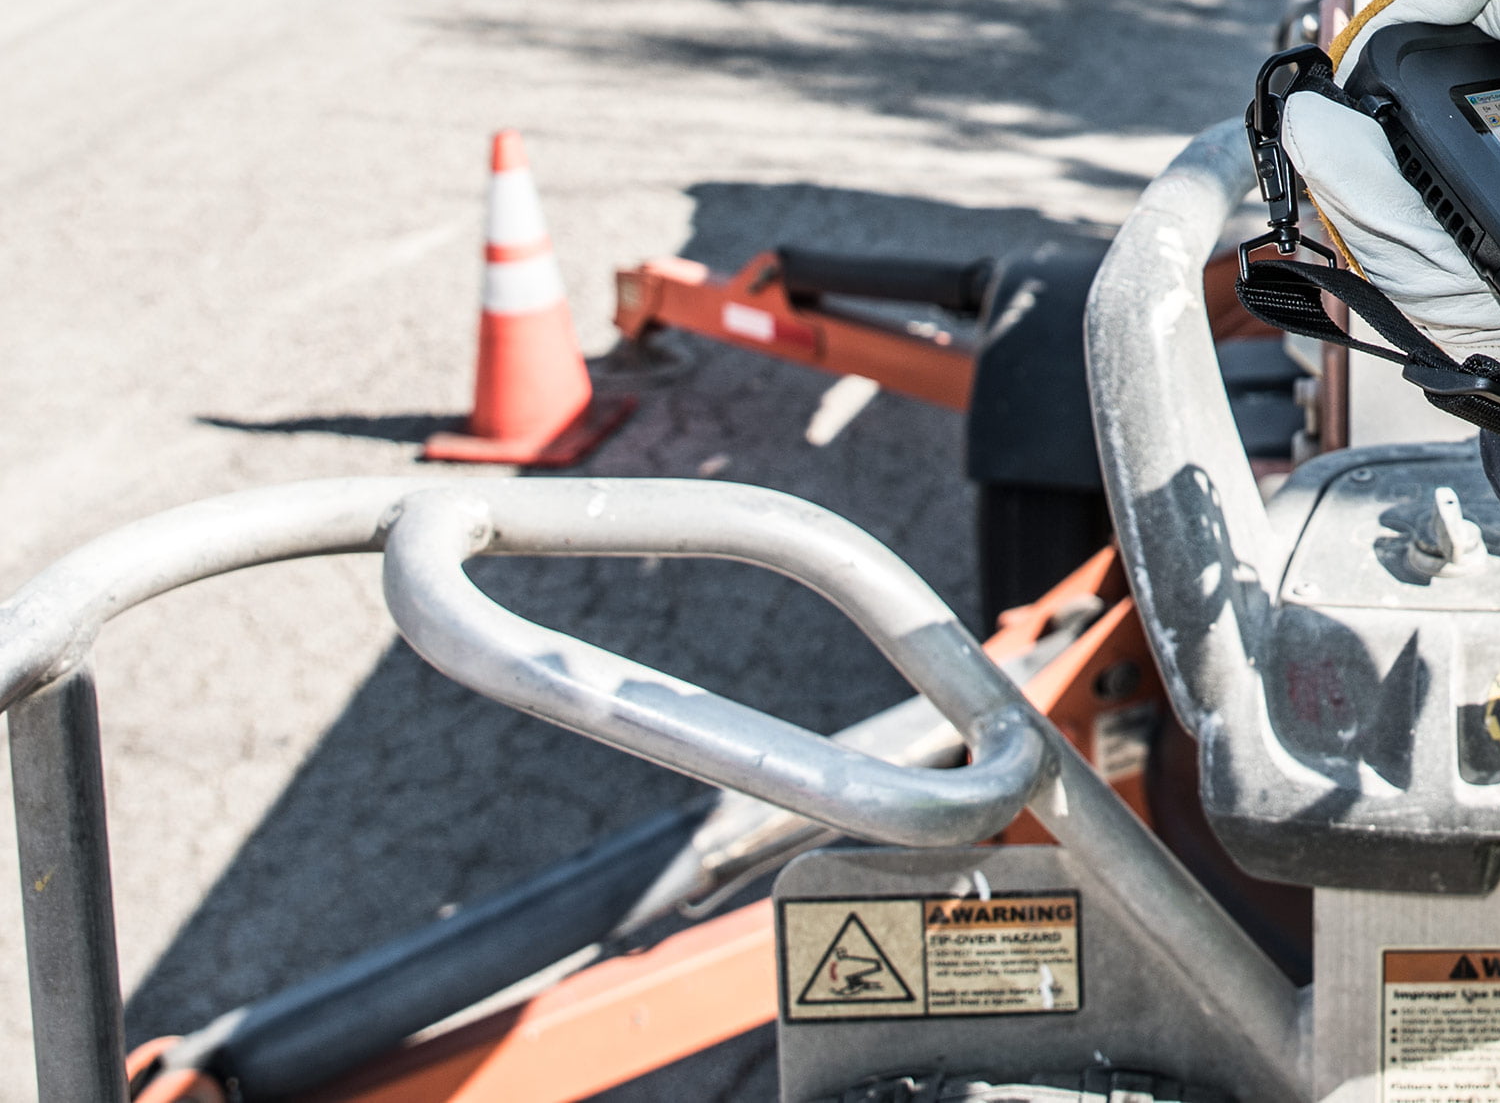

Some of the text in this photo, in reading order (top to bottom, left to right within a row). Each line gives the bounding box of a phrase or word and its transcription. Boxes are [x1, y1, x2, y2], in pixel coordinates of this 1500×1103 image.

[952, 905, 1073, 923] WARNING
[929, 931, 1062, 946] TIP-OVER HAZARD
[1394, 990, 1457, 1001] Improper
